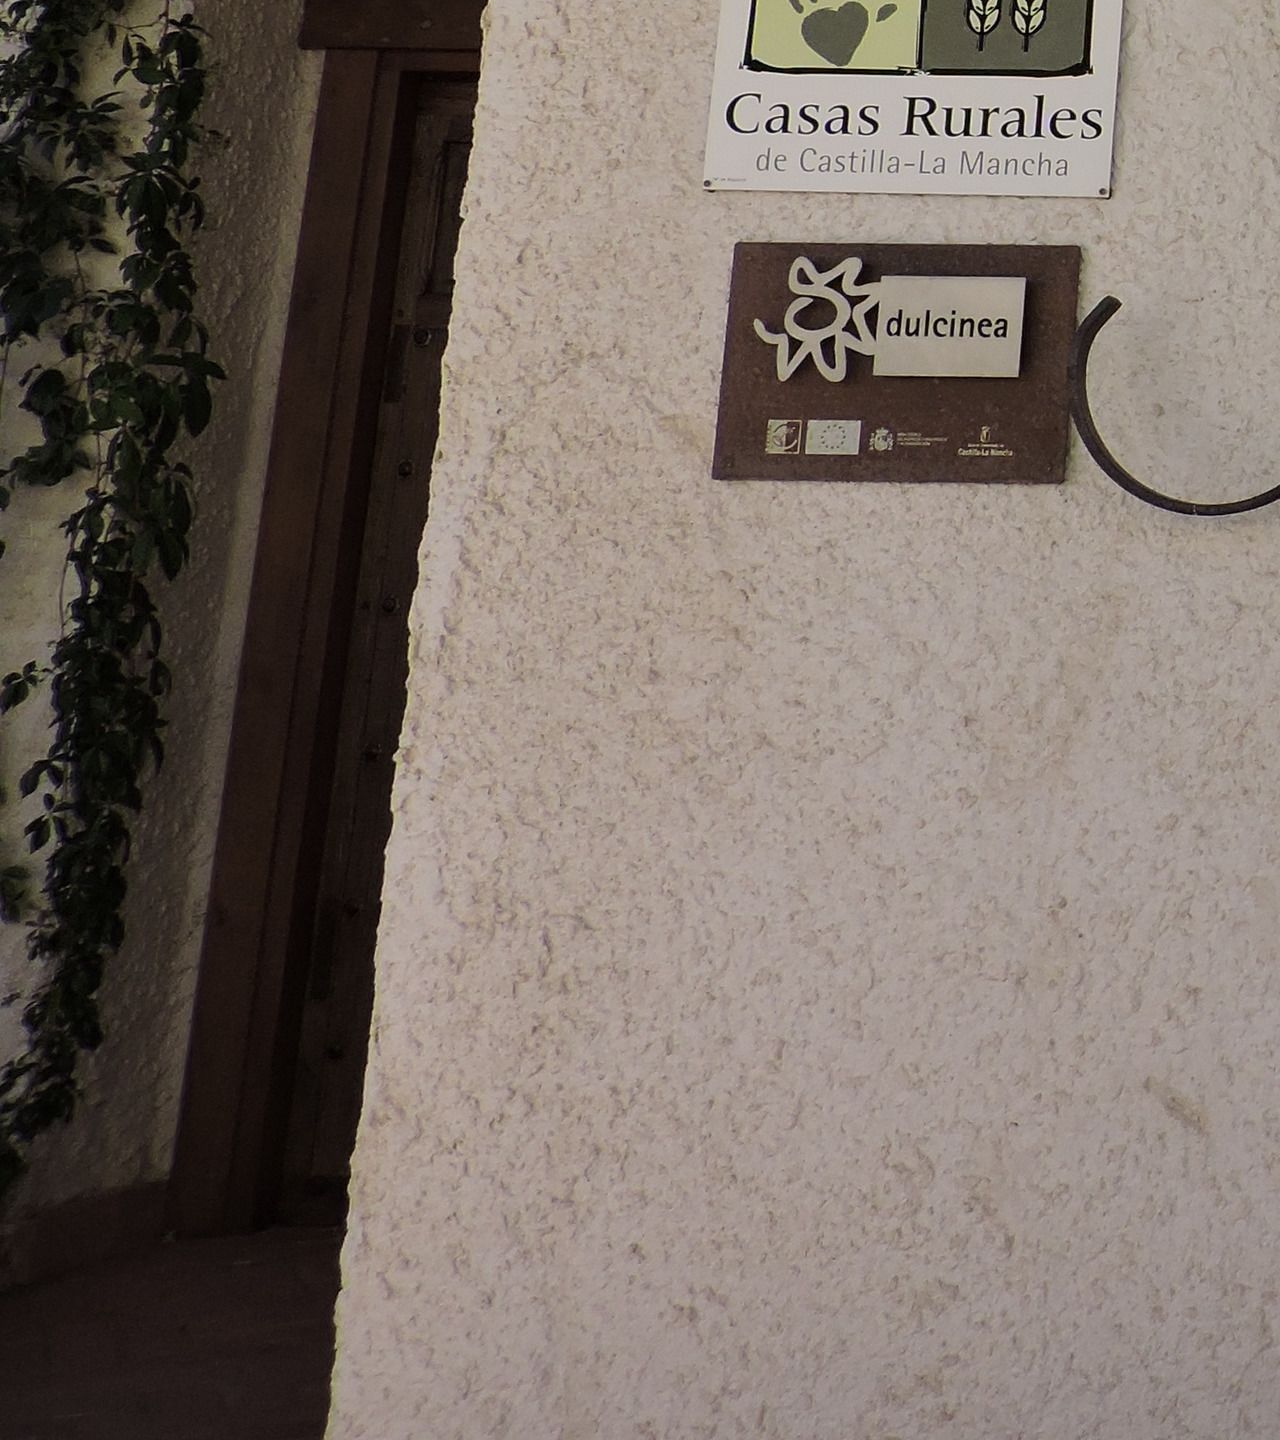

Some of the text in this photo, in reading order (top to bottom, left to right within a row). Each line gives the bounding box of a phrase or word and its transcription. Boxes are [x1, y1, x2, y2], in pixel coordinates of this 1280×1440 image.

[725, 93, 1103, 140] Casas Rurales
[755, 147, 1069, 177] de Castilla-La Mancha
[885, 308, 1009, 339] dulcinea
